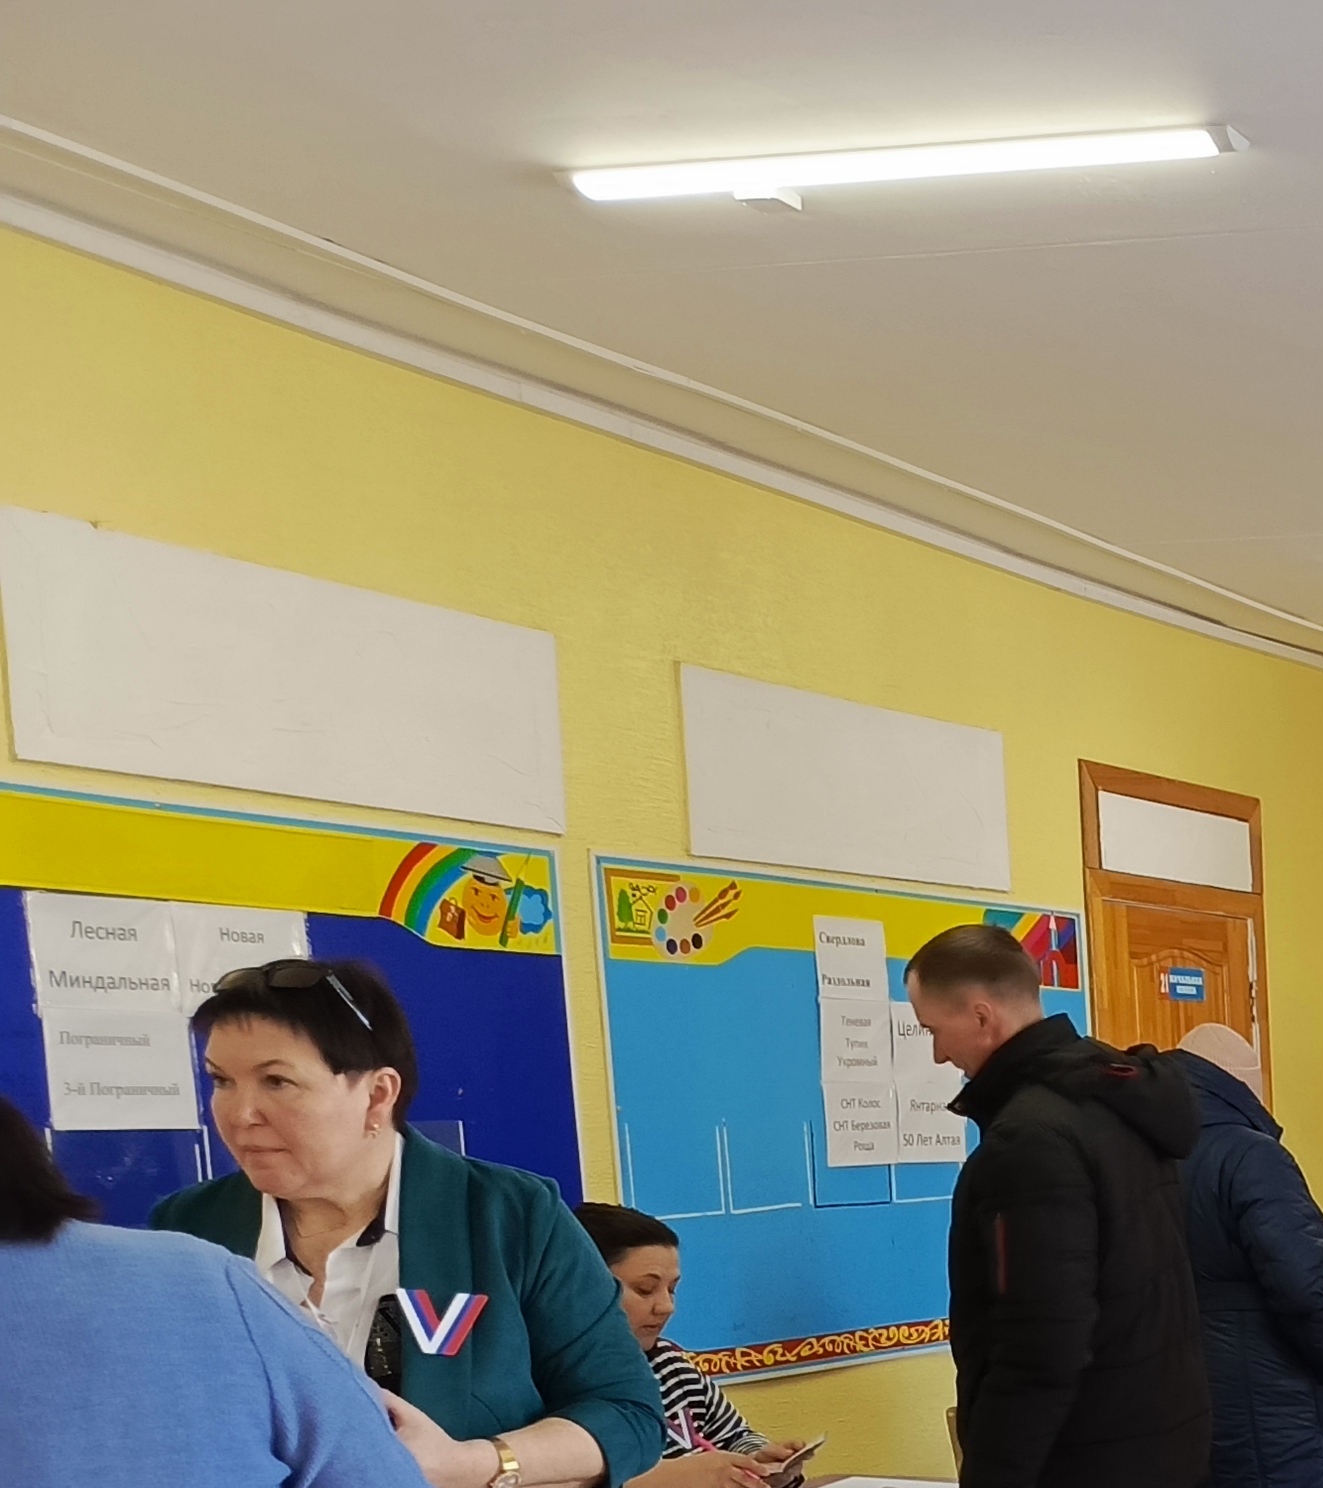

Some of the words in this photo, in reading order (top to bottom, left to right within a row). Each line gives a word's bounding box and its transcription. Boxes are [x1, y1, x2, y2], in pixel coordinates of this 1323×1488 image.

[70, 921, 138, 942] Лесная
[219, 927, 265, 944] Новая
[819, 931, 866, 948] Свердлова
[49, 970, 171, 993] Миндальная
[821, 973, 871, 988] Раздольная
[841, 1015, 872, 1027] Теневая
[59, 1031, 151, 1048] Пограничный
[845, 1037, 869, 1050] Тупик
[90, 1082, 180, 1099] Пограничный
[903, 1133, 915, 1147] 50
[916, 1133, 933, 1147] Лет
[935, 1133, 960, 1147] Алтая
